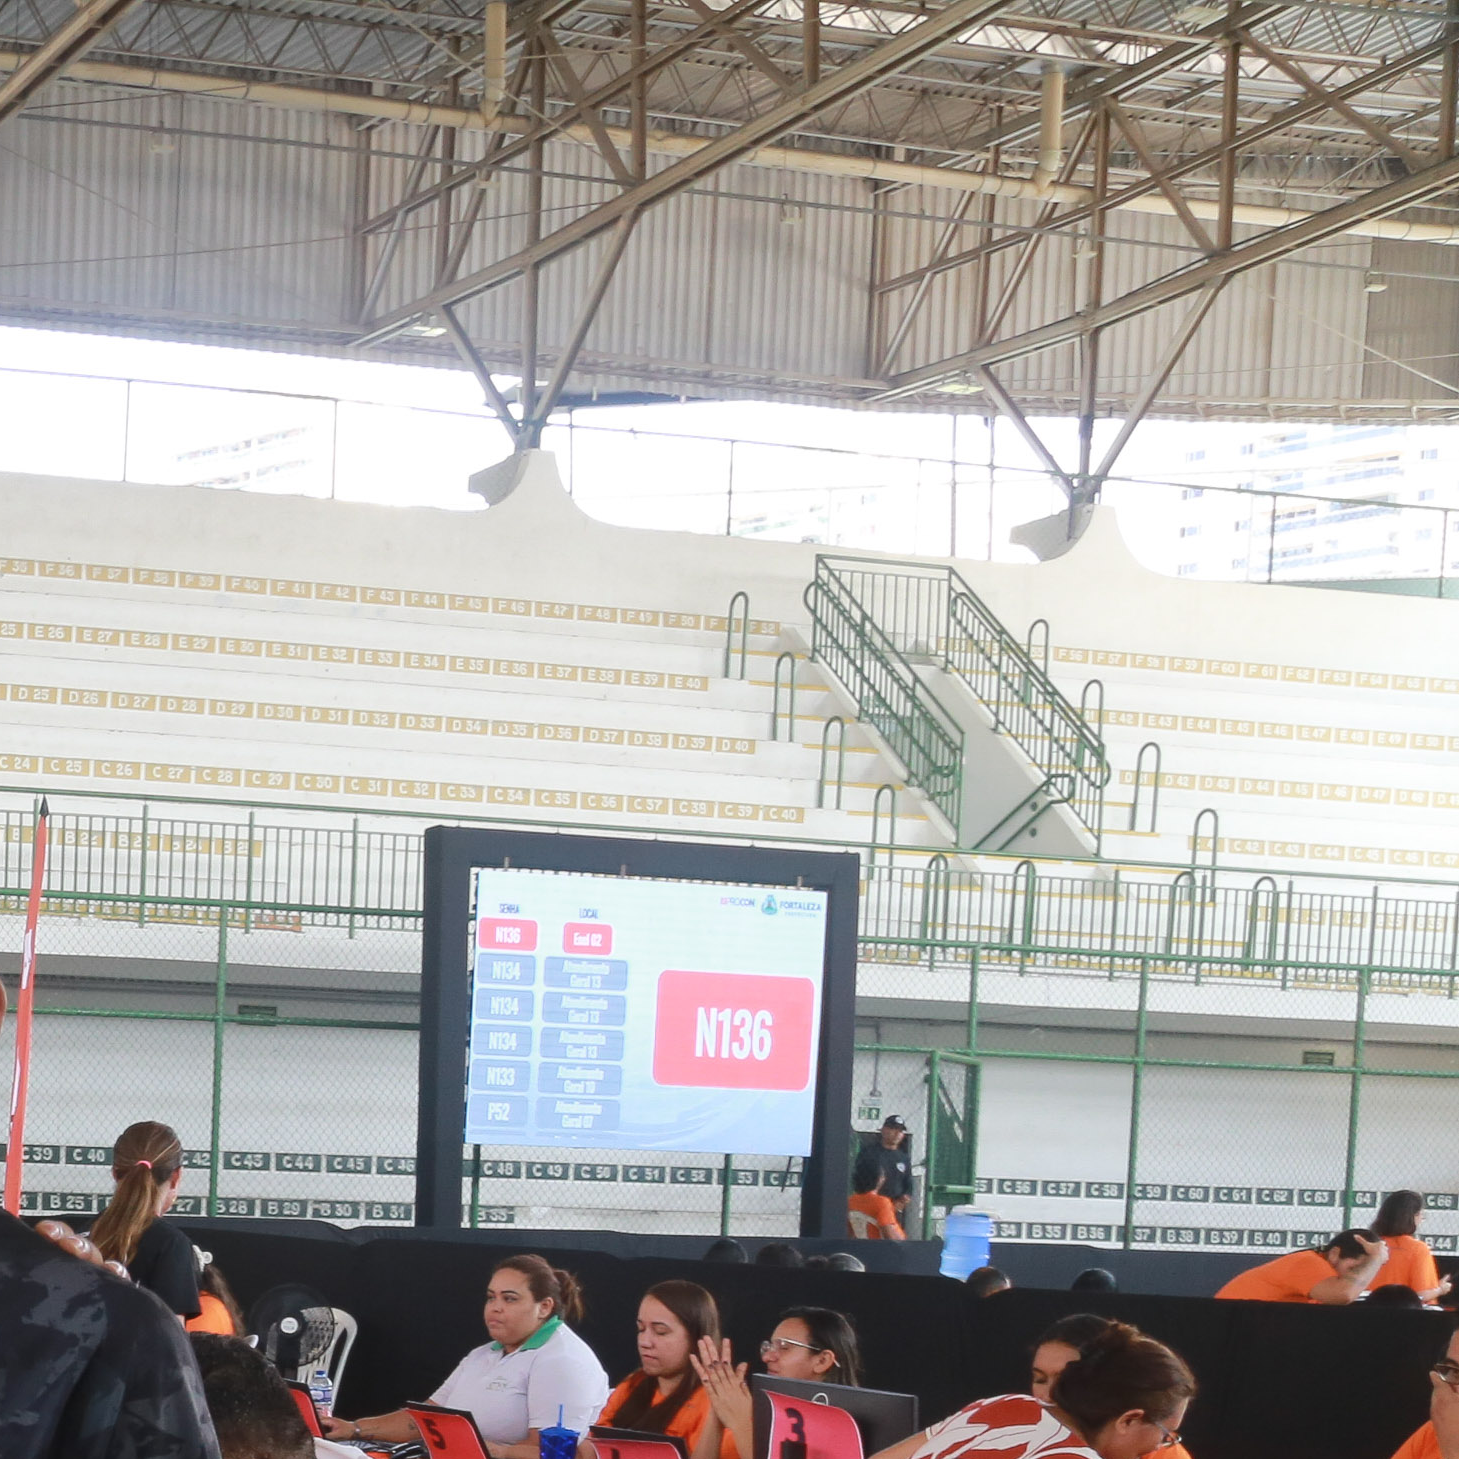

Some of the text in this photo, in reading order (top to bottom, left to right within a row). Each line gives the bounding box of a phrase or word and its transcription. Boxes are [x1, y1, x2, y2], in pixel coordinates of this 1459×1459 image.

[579, 908, 598, 919] LOCAL
[780, 901, 821, 911] FORTALEZA
[495, 926, 521, 944] N136
[492, 962, 520, 981] N134
[490, 997, 519, 1015] N134
[489, 1032, 517, 1050] N134
[695, 1007, 772, 1061] N136
[486, 1067, 515, 1086] N133
[488, 1103, 511, 1121] P52
[422, 1417, 445, 1448] 5
[784, 1407, 807, 1442] 3
